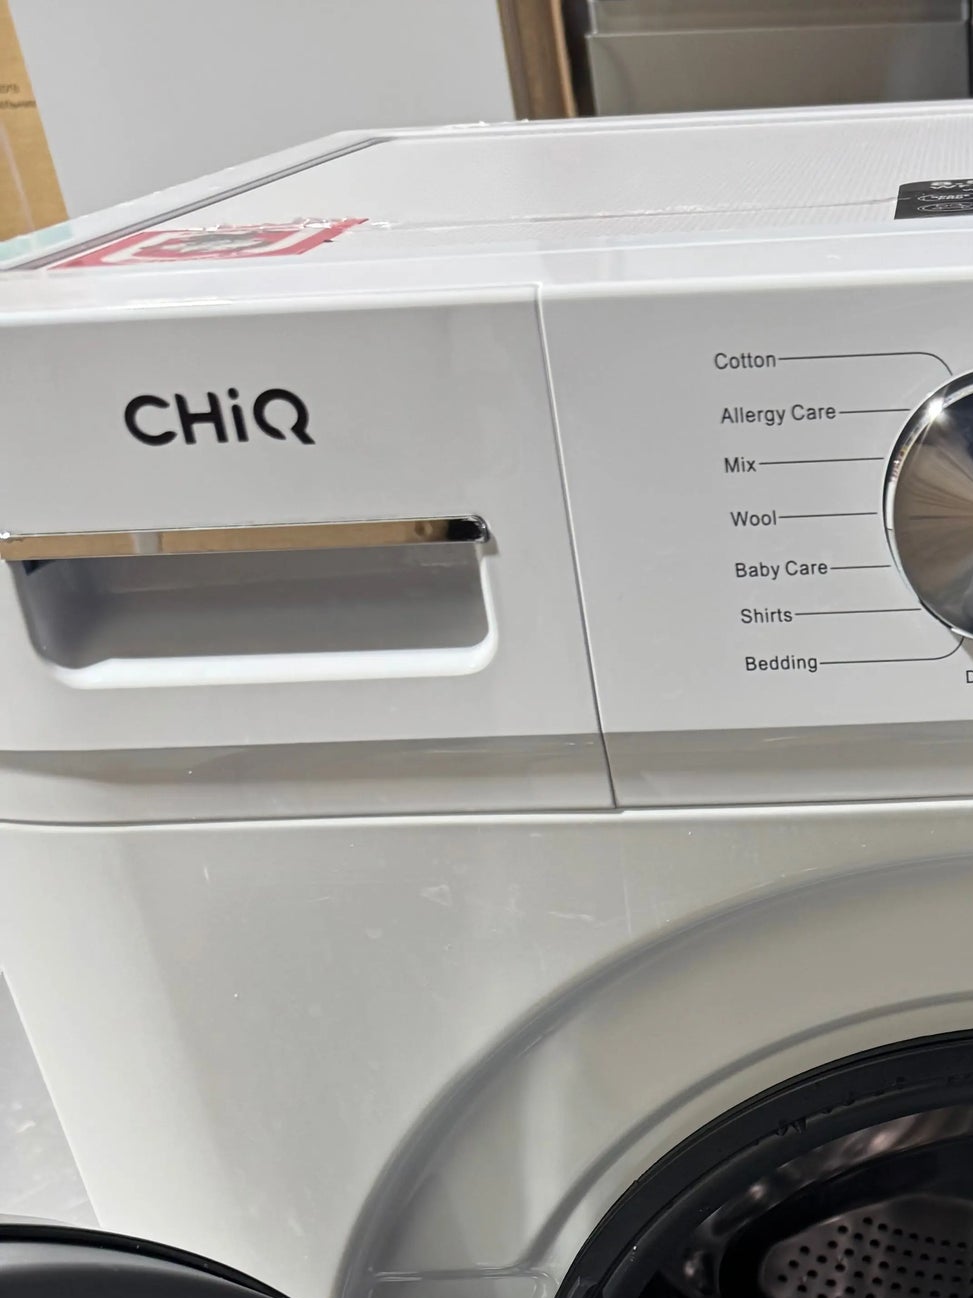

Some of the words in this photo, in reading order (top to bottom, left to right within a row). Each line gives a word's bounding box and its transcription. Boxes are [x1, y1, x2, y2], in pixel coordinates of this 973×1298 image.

[714, 352, 776, 370] Cotton
[124, 387, 316, 447] CHiQ
[720, 407, 786, 426] Allergy
[790, 404, 837, 421] Care
[724, 456, 757, 473] Mix
[730, 510, 777, 527] Wool
[735, 562, 780, 580] Baby
[785, 560, 828, 576] Care
[740, 607, 793, 624] Shirts
[745, 655, 818, 673] Bedding
